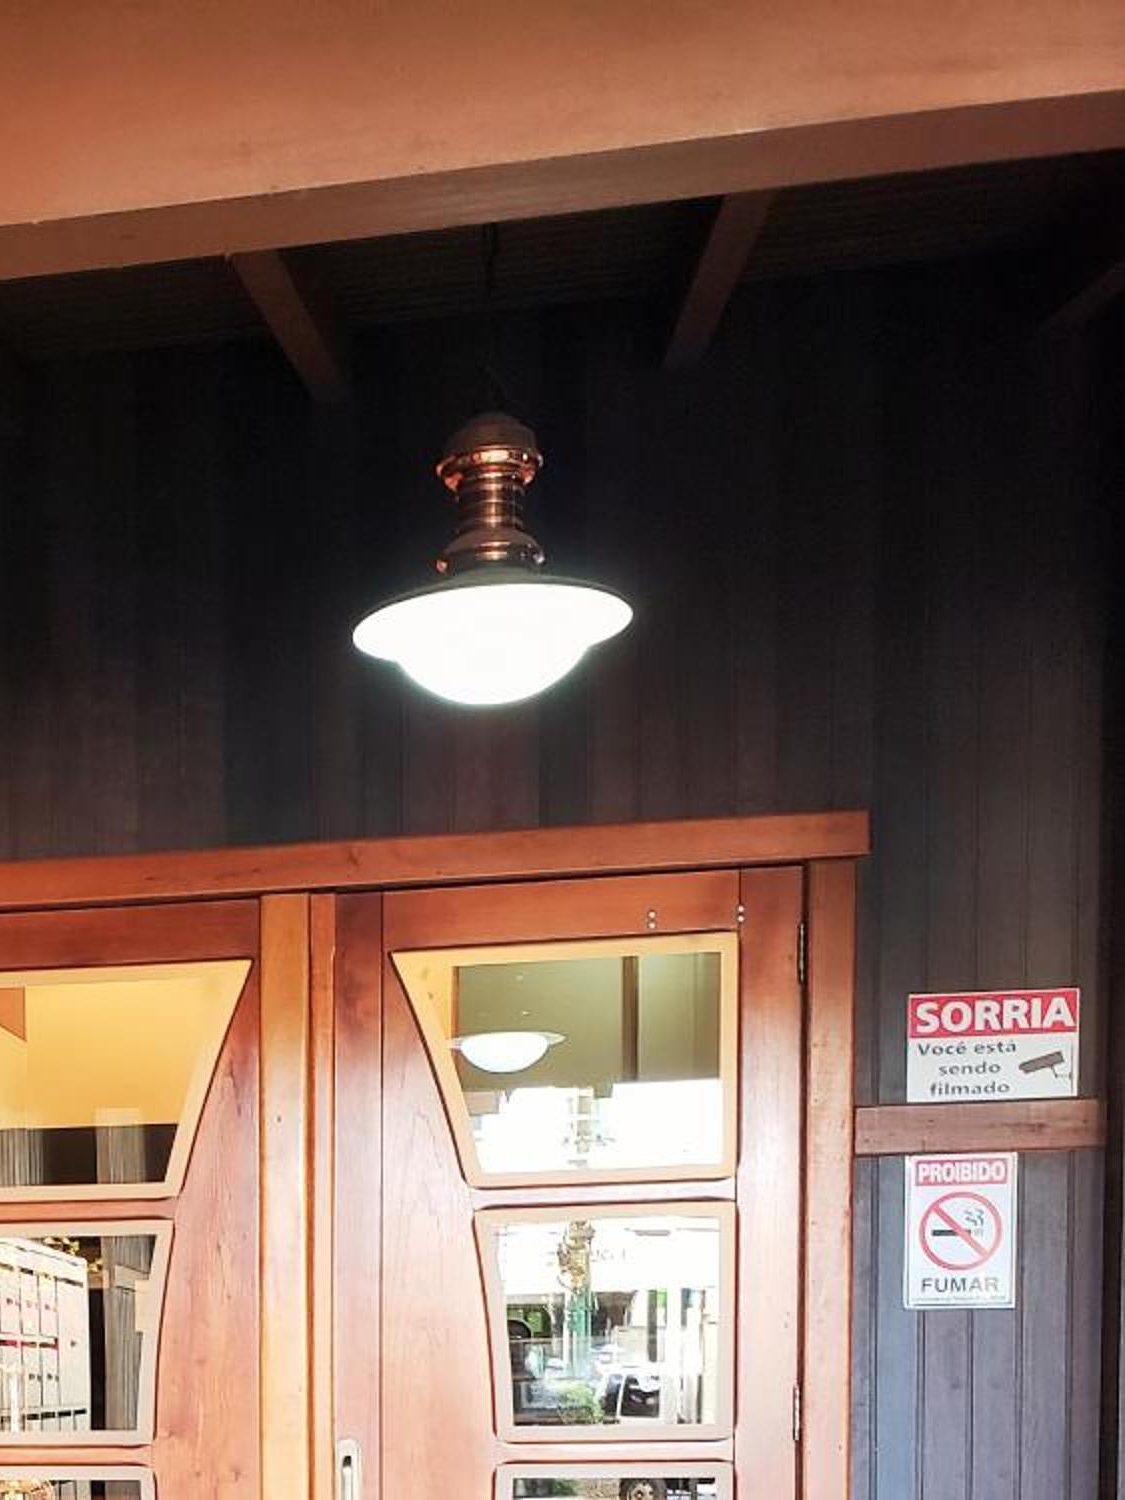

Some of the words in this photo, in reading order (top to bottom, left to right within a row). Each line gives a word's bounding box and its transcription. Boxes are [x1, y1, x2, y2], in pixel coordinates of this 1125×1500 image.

[916, 997, 1075, 1033] SORRIA
[918, 1040, 967, 1055] Você
[974, 1040, 1017, 1054] está
[939, 1062, 1001, 1076] sendo
[930, 1081, 1010, 1096] filmado
[918, 1160, 1005, 1183] PROIBIDO
[921, 1277, 999, 1293] FUMAR
